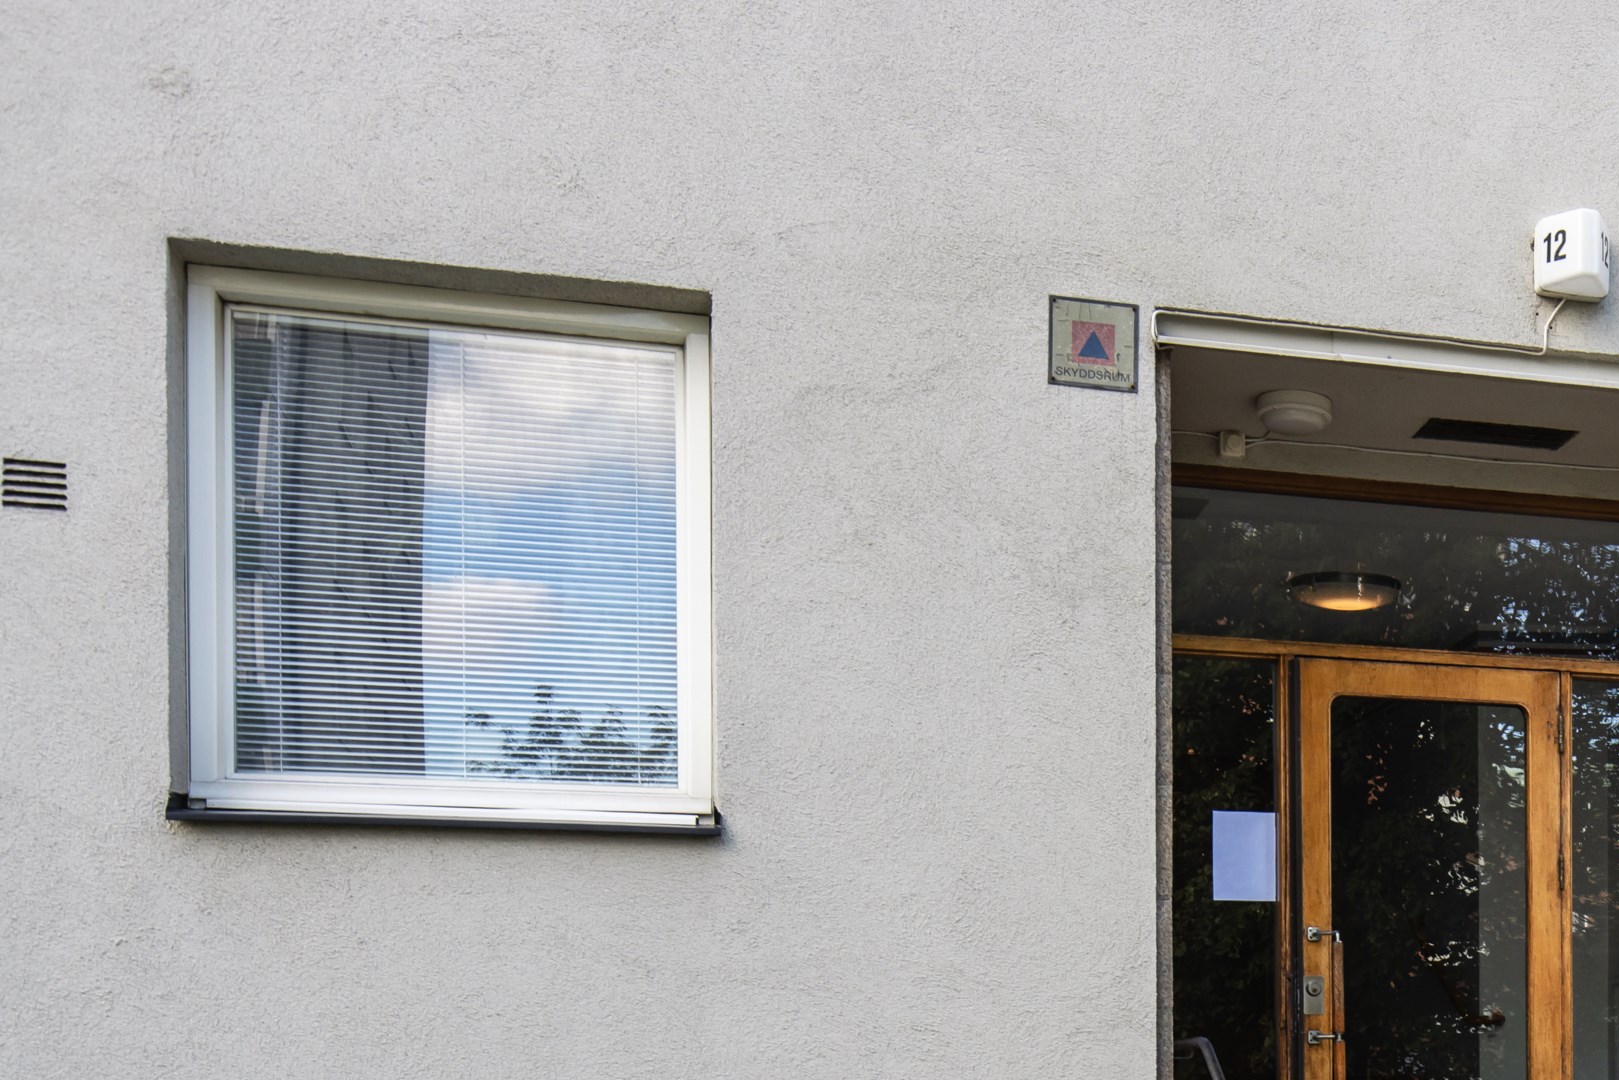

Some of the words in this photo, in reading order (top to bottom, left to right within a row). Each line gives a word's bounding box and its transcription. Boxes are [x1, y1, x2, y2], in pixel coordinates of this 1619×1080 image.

[1543, 229, 1567, 263] 12
[1600, 231, 1609, 269] 12
[1054, 366, 1131, 383] SKYDDSRUM
